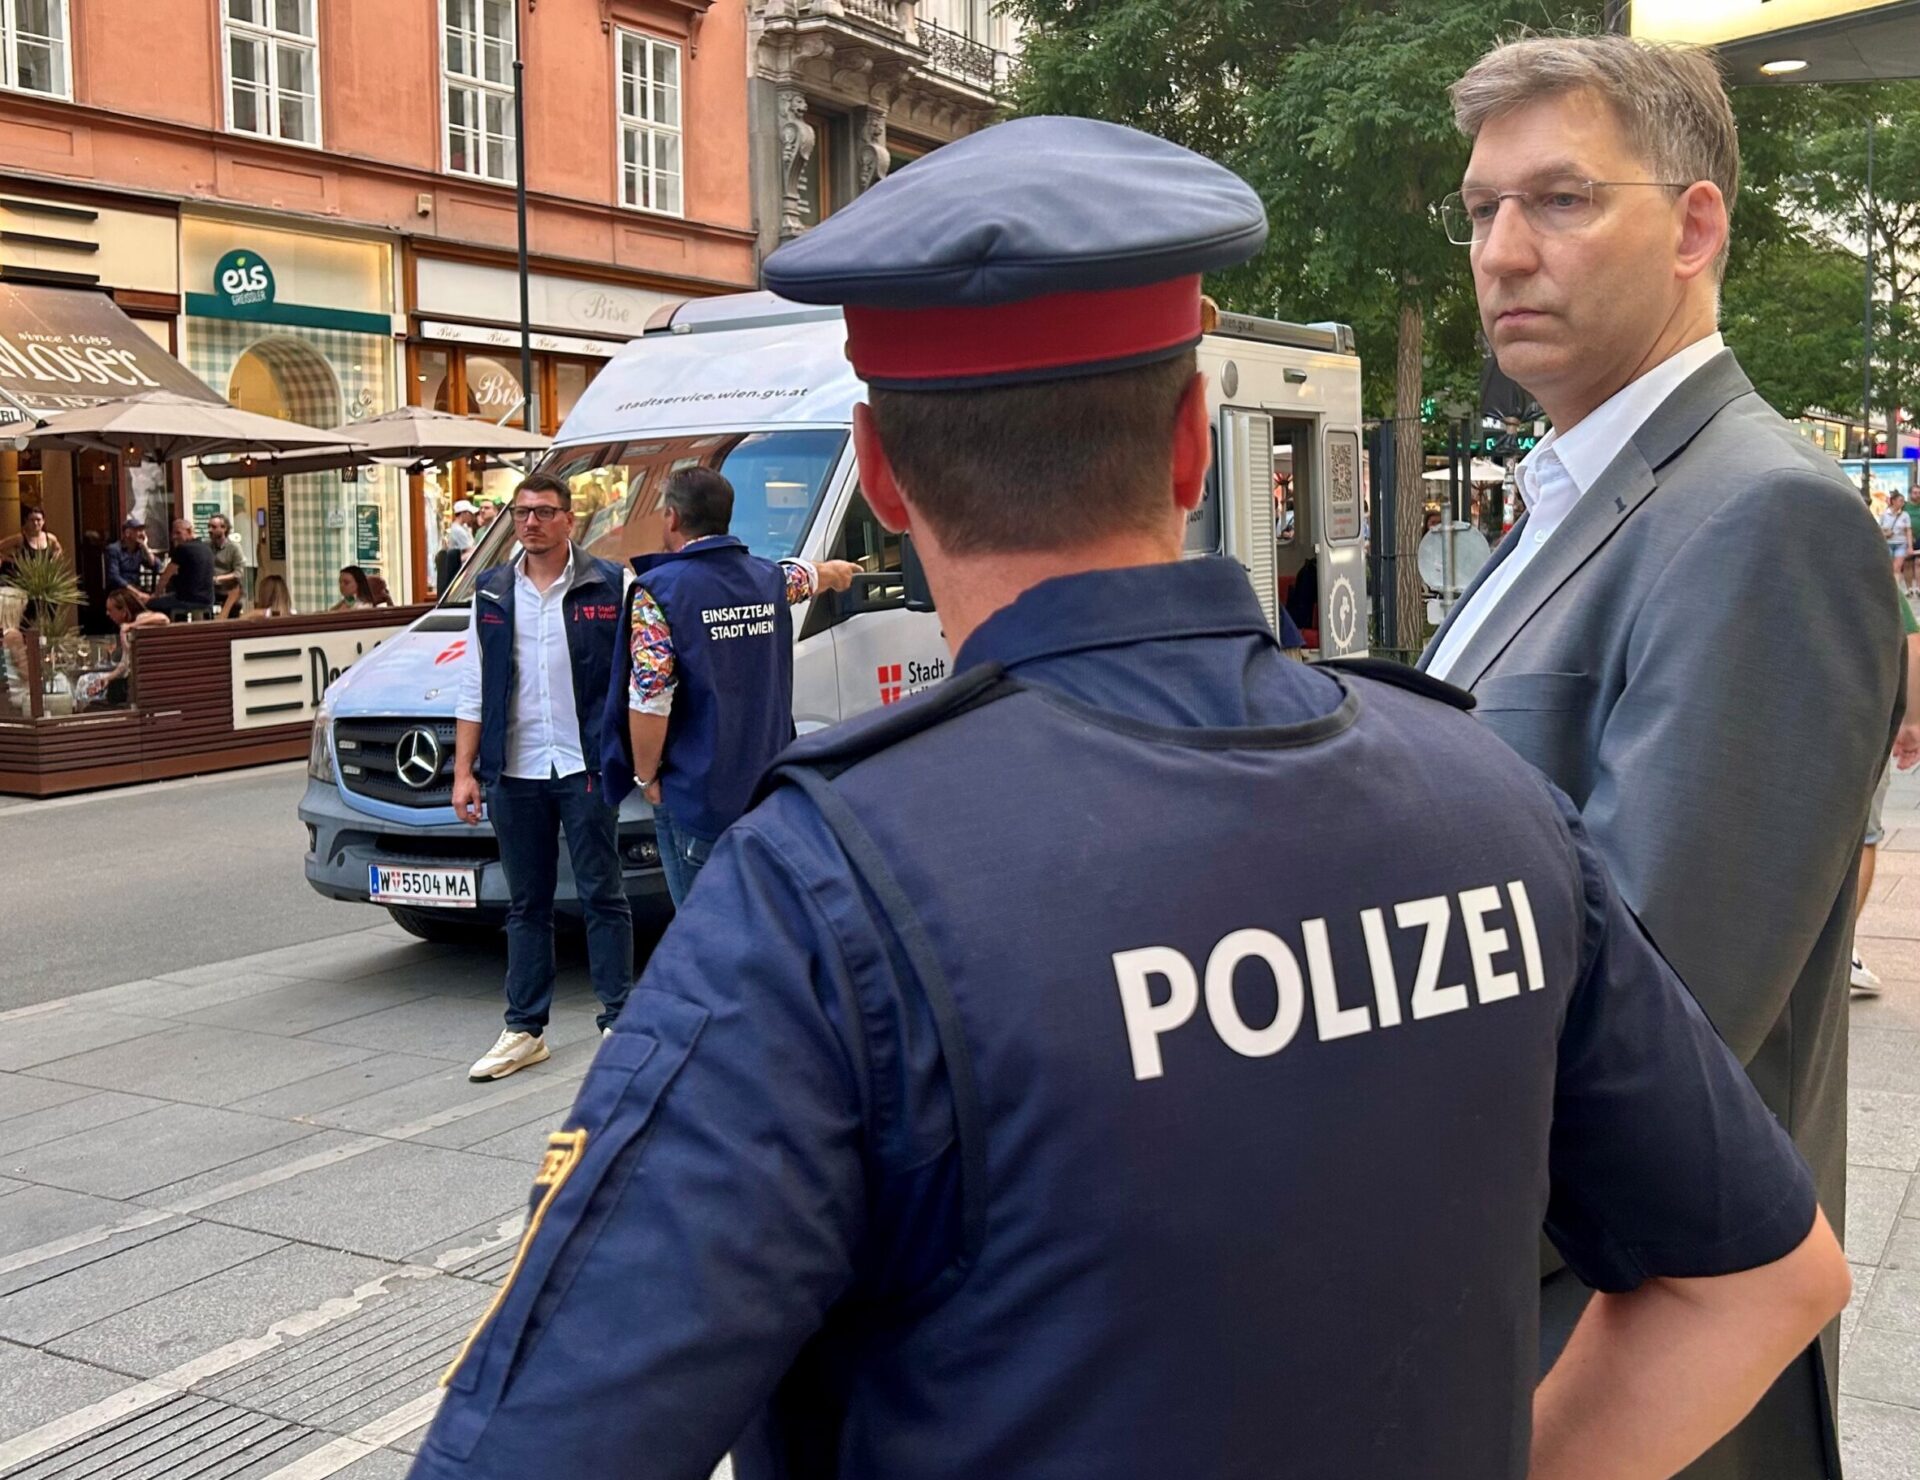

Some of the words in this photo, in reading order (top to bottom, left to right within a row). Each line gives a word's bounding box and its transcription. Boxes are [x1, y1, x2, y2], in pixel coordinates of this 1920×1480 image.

[222, 257, 268, 295] eis
[584, 293, 630, 322] Bise
[18, 331, 63, 344] since
[475, 372, 523, 406] Bis
[615, 387, 808, 413] stadtservice.wien.gv.at
[701, 603, 775, 624] EINSATZTEAM
[710, 623, 746, 640] STADT
[746, 620, 774, 636] WIEN
[908, 658, 945, 684] Stadt
[380, 871, 391, 892] W
[402, 873, 441, 896] 5504
[445, 875, 471, 897] MA
[1112, 880, 1545, 1081] POLIZEI
